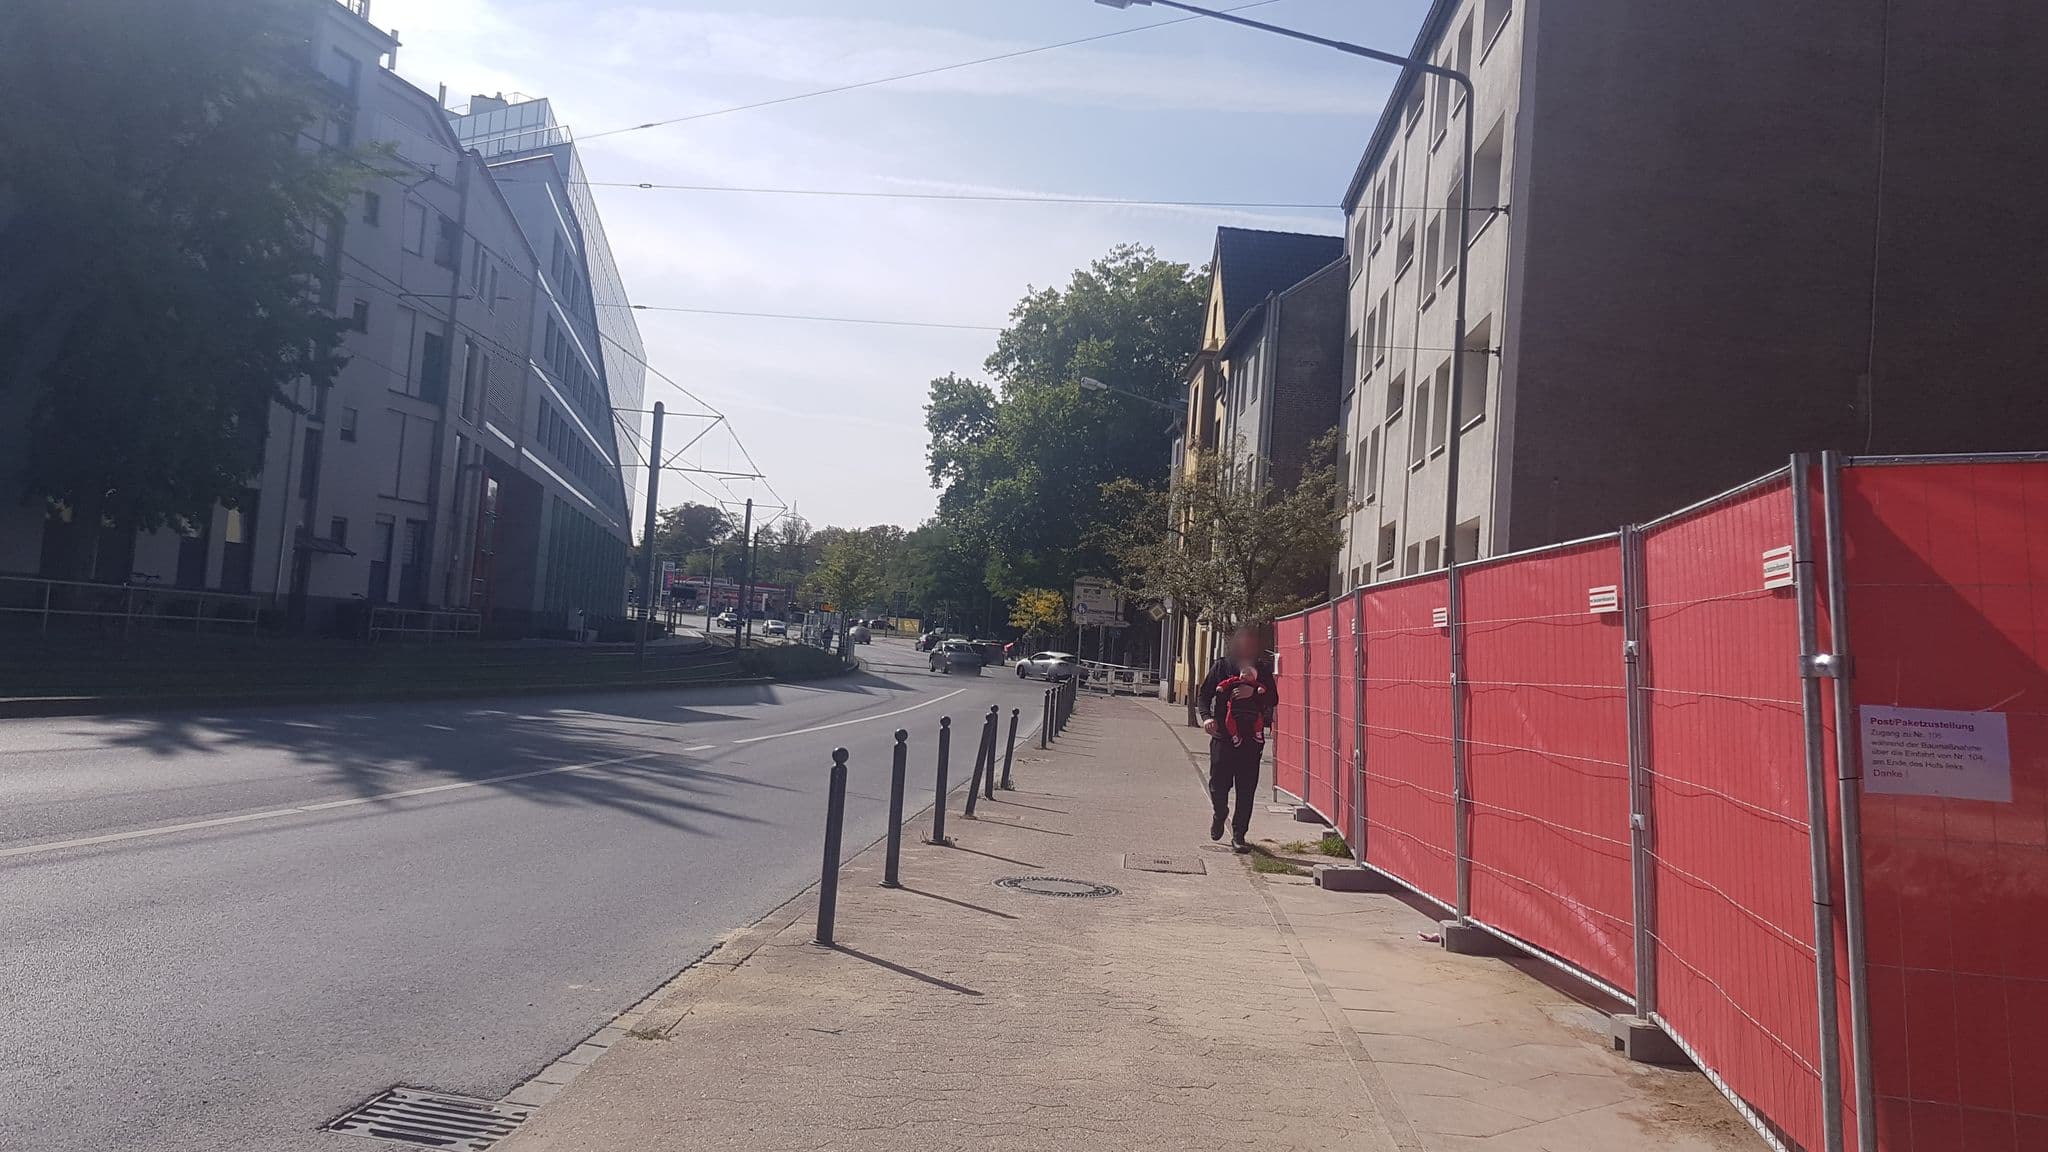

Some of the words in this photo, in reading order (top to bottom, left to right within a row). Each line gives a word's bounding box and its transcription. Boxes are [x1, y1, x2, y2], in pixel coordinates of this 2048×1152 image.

[1870, 717, 1974, 732] Post/Paketzustellung
[1871, 728, 1900, 738] Zugang
[1871, 740, 1904, 748] während
[1905, 749, 1935, 758] Einfahrt
[1886, 759, 1907, 767] Ende
[1925, 761, 1943, 769] Hofs
[1873, 768, 1903, 778] Danke
